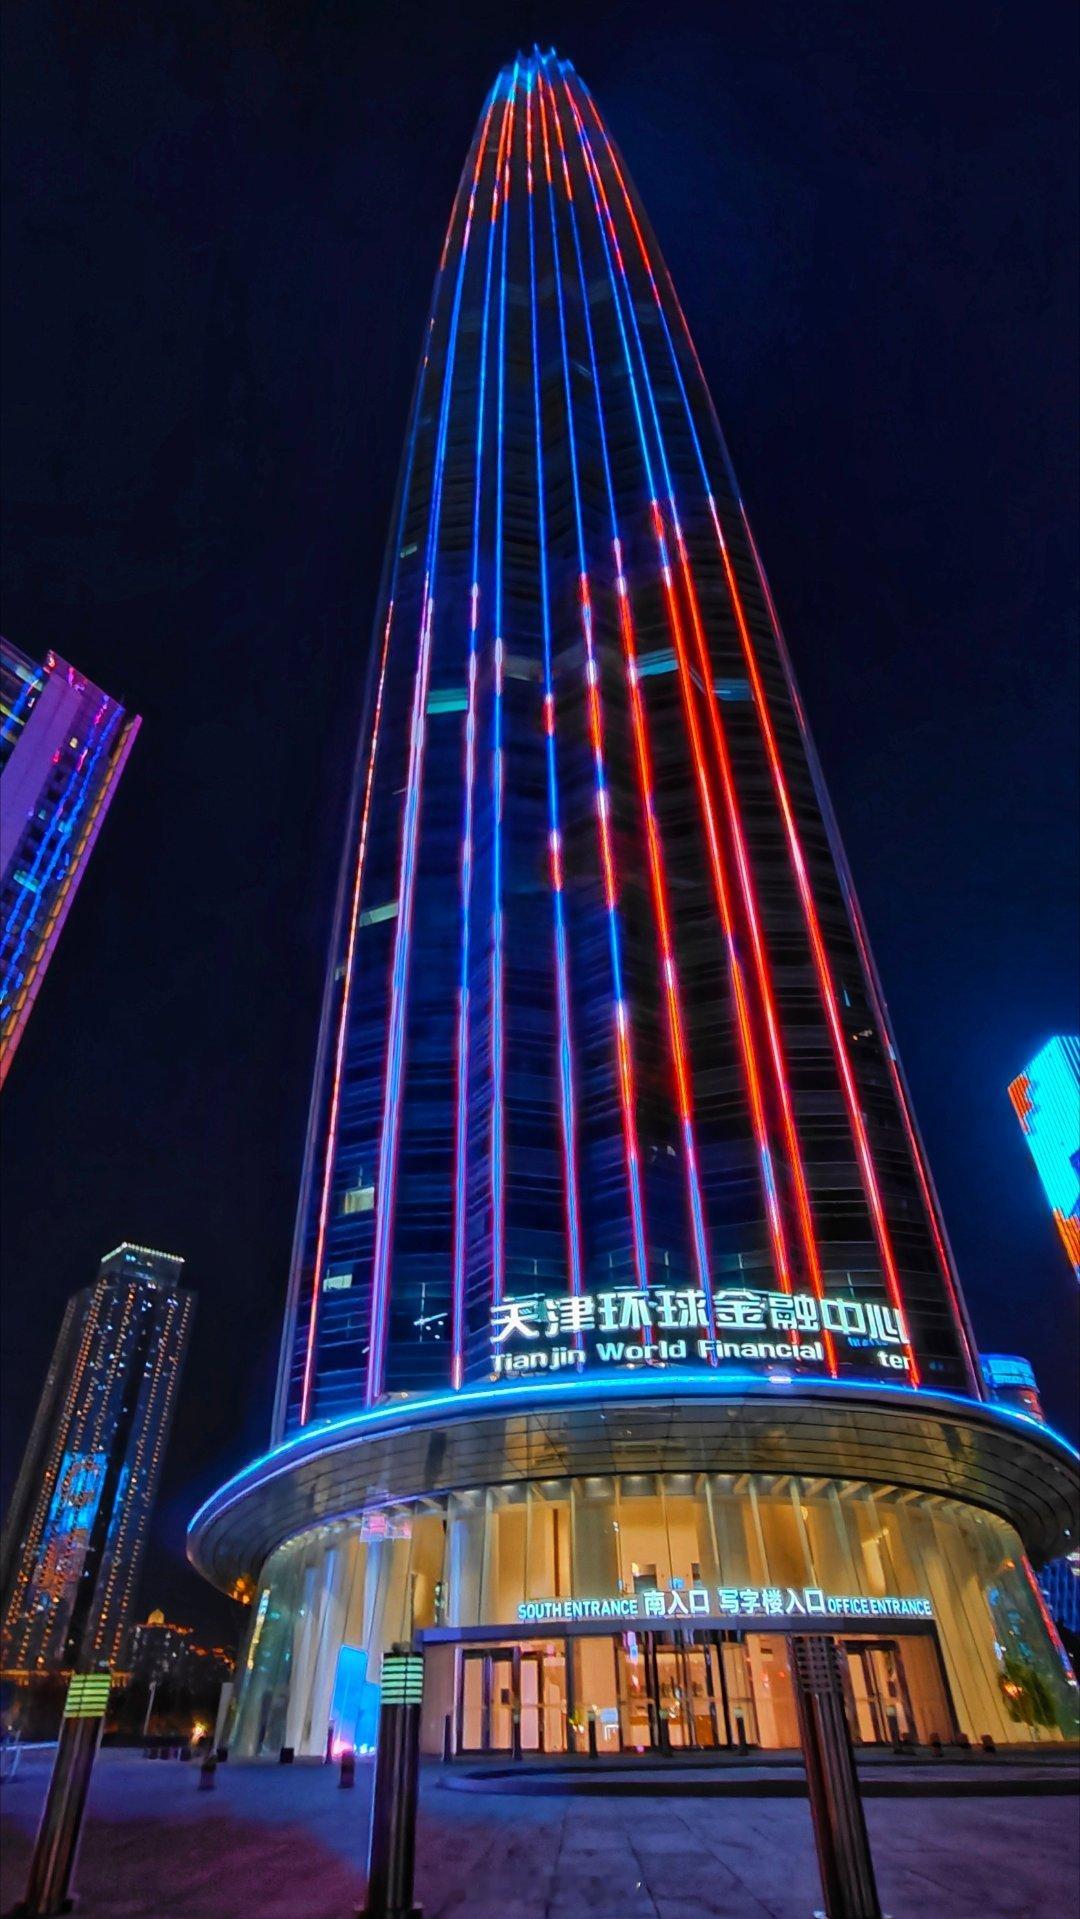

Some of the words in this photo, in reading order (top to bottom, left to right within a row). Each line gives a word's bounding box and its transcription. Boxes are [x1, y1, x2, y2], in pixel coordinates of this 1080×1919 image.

[490, 1288, 909, 1345] 天津环球金融中心
[490, 1346, 586, 1375] Tianjin
[595, 1340, 687, 1362] World
[698, 1338, 823, 1363] Financial
[518, 1602, 563, 1619] SOUTH
[565, 1599, 638, 1617] ENTRANCE
[644, 1589, 710, 1615] 南入口
[718, 1588, 825, 1615] 写字楼入口
[827, 1598, 872, 1614] OFFICE
[872, 1599, 932, 1616] ENTRANCE
